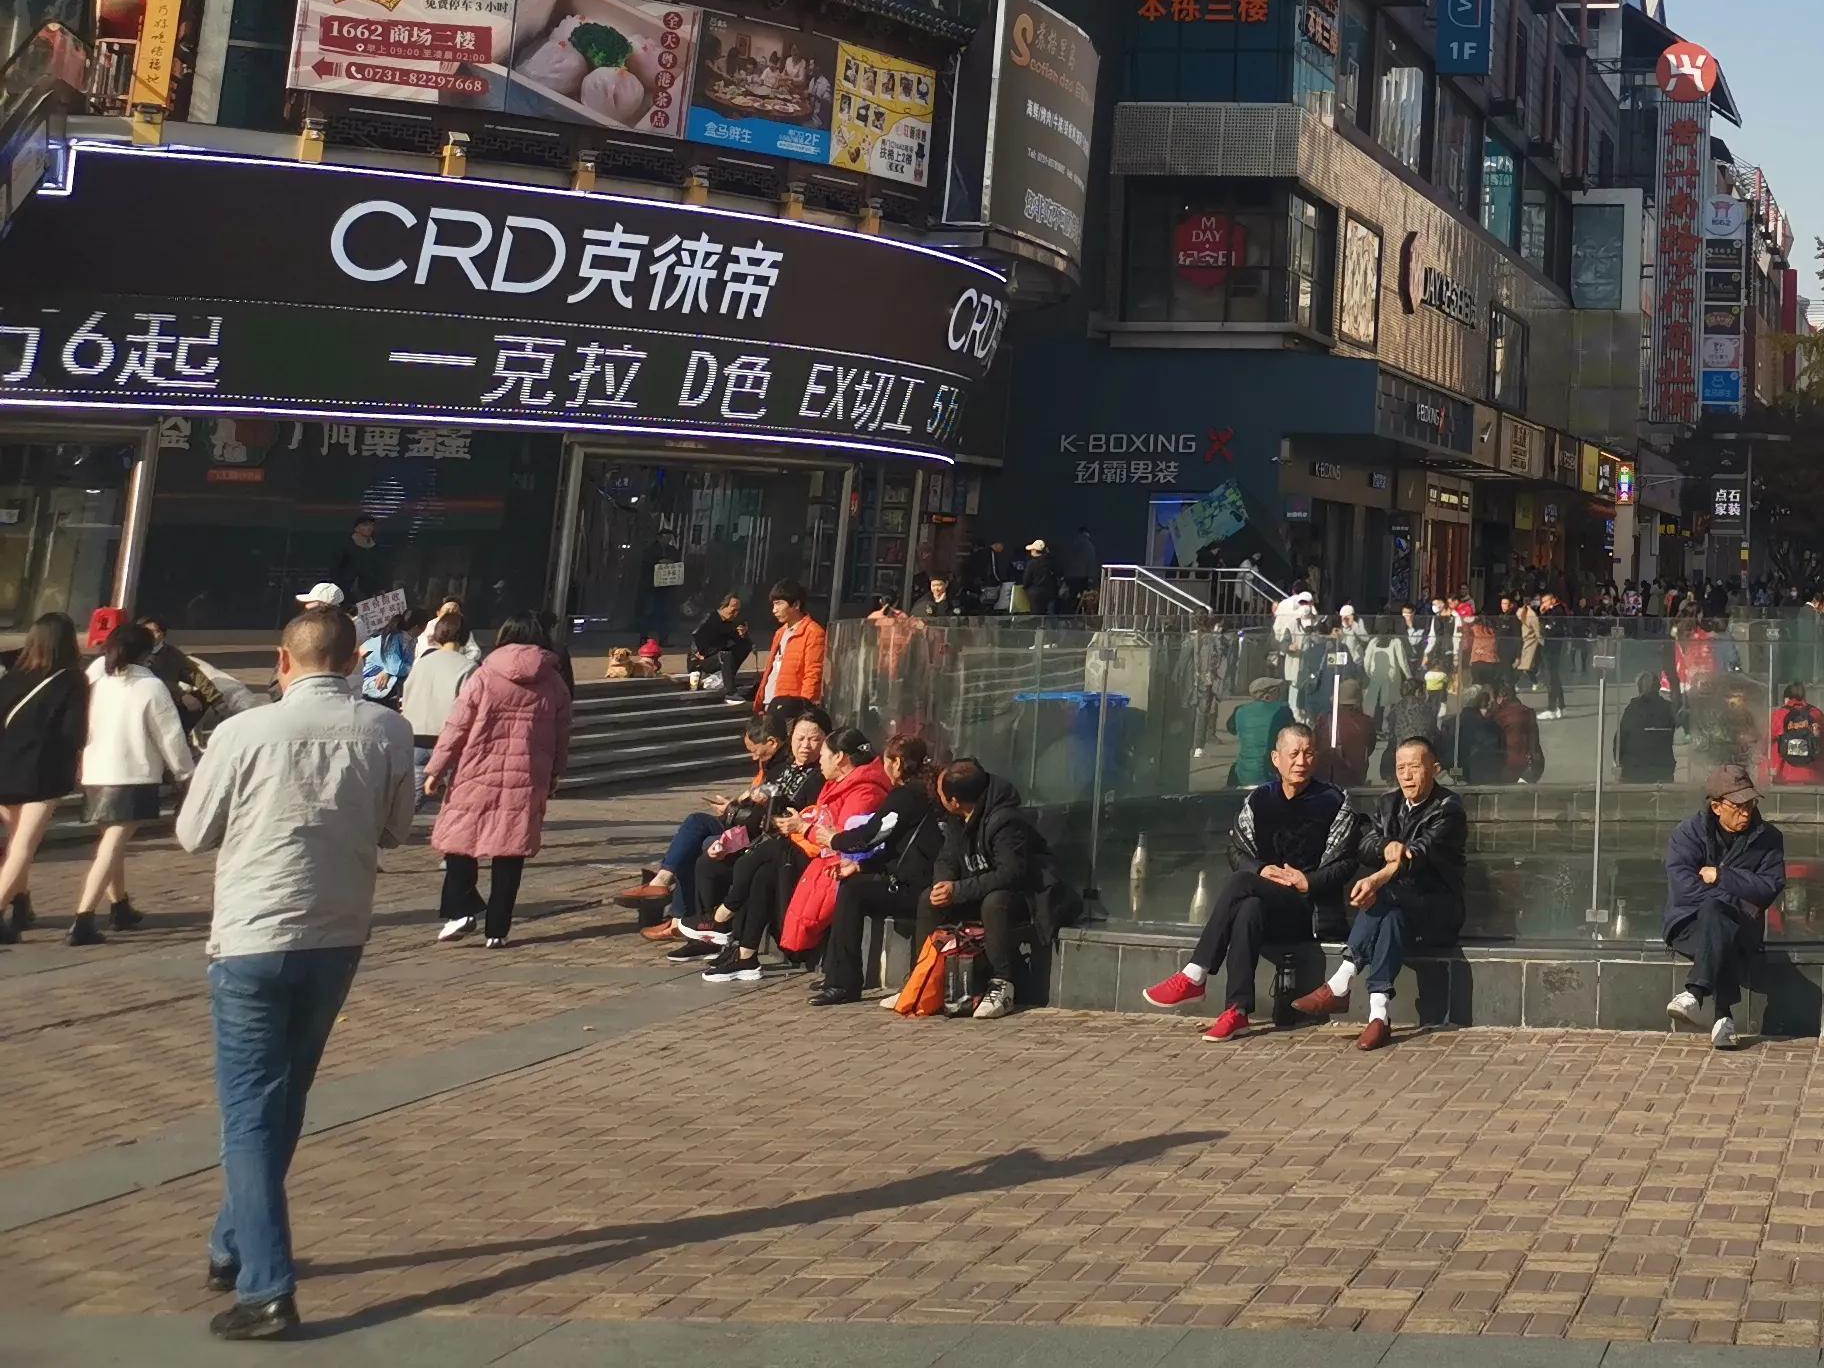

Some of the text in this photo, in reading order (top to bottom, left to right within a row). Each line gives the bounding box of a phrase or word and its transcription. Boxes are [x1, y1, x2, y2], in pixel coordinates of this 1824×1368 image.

[329, 20, 476, 50] 1662 商场二楼
[366, 44, 388, 55] 早上
[390, 46, 420, 58] 09:00
[456, 52, 485, 62] 02:00
[1449, 41, 1478, 60] 1F
[364, 67, 482, 91] 0731-82297668
[704, 121, 753, 144] 盒马鲜生
[804, 132, 821, 146] 2F
[1201, 216, 1216, 230] M
[1191, 229, 1224, 242] DAY
[388, 334, 639, 411] 一克拉
[681, 350, 773, 421] D色
[1059, 434, 1197, 454] K-BOXING
[1074, 461, 1181, 484] 劲霸男装
[1715, 489, 1741, 502] 点石
[1714, 503, 1741, 516] 家装
